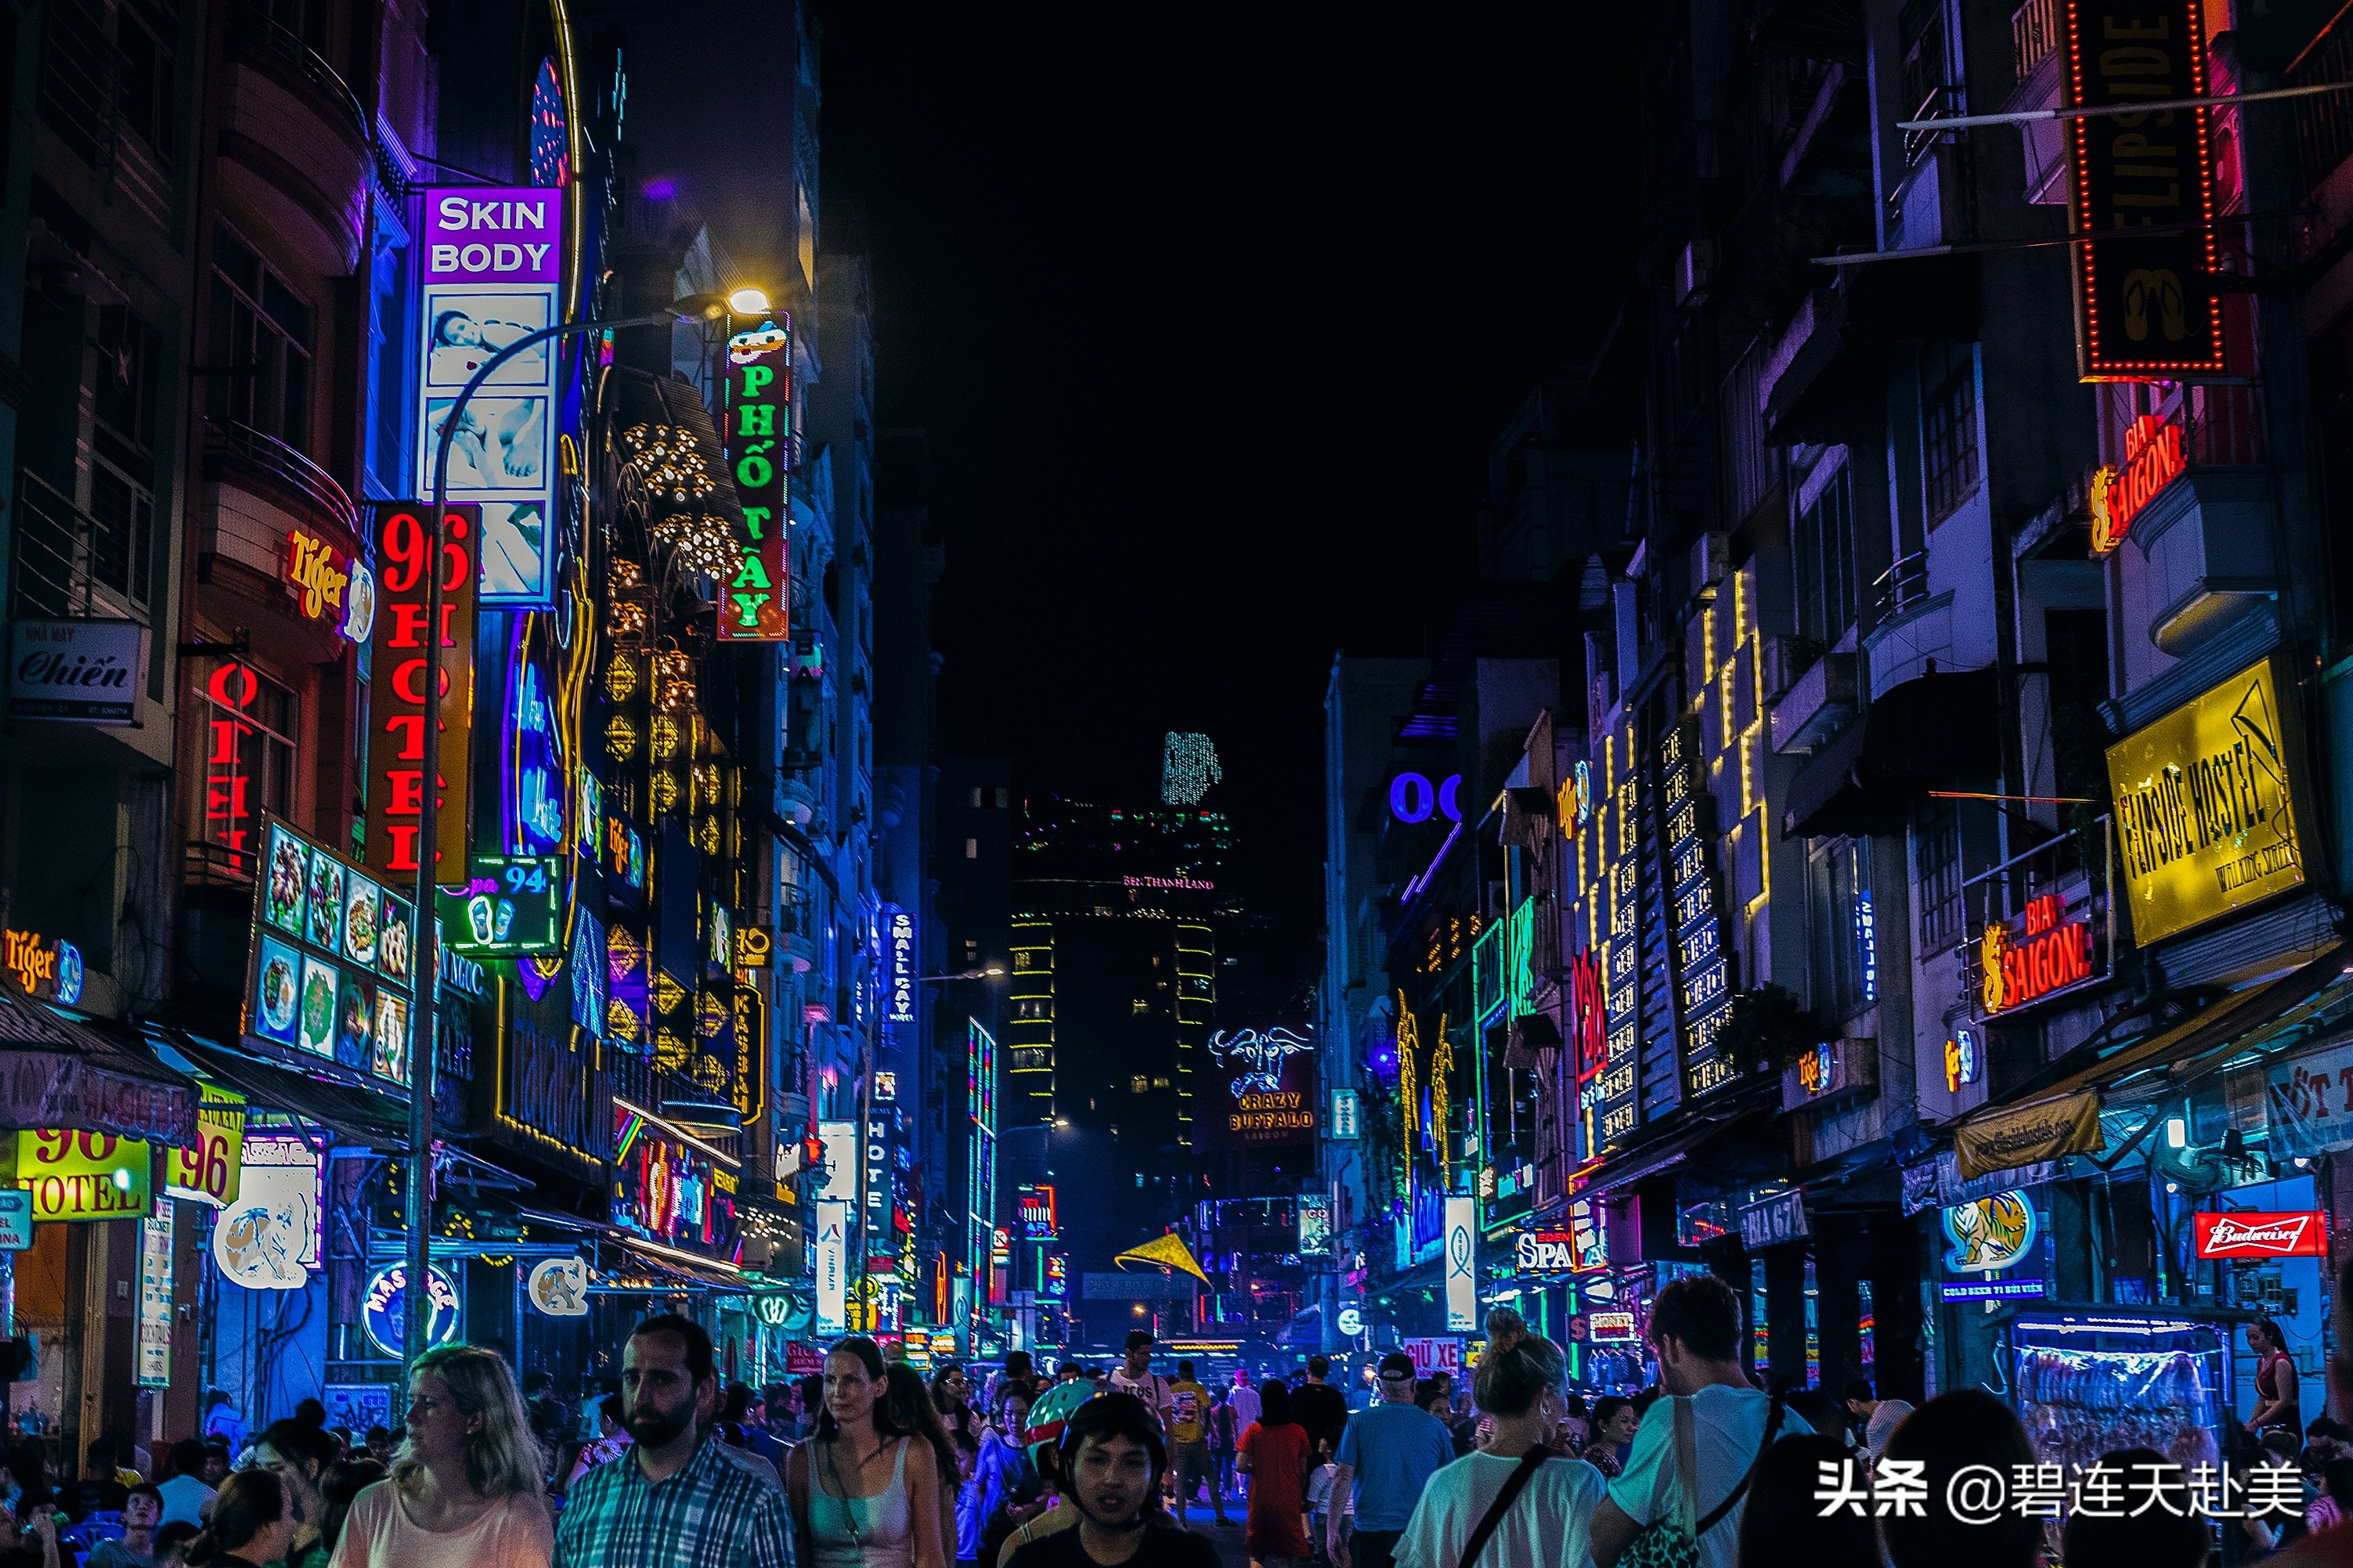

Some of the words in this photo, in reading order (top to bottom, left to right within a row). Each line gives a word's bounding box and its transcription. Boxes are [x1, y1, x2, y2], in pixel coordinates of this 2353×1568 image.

[2099, 15, 2180, 236] FLIPSIDE
[438, 196, 546, 231] SKIN
[431, 243, 551, 272] BODY
[2124, 415, 2148, 463] BIA
[382, 513, 469, 593] 96
[291, 529, 348, 618] Tiger
[384, 603, 458, 871] HOTEL
[2188, 734, 2267, 849] HOSTEL
[503, 863, 548, 895] 94
[1185, 878, 1214, 890] LAND
[2026, 896, 2053, 936] BIA
[5, 928, 55, 993] Tiger
[893, 914, 912, 974] SMALL
[895, 977, 911, 1014] BAY
[1238, 1092, 1301, 1111] CRAZY
[1229, 1111, 1315, 1131] BUFFALO
[867, 1121, 885, 1231] HOTEL
[1518, 1233, 1573, 1269] SPA
[1536, 1233, 1571, 1243] EDEN
[2210, 1225, 2301, 1244] Budweiser
[366, 1269, 459, 1313] MASGE
[1436, 1343, 1458, 1368] XE
